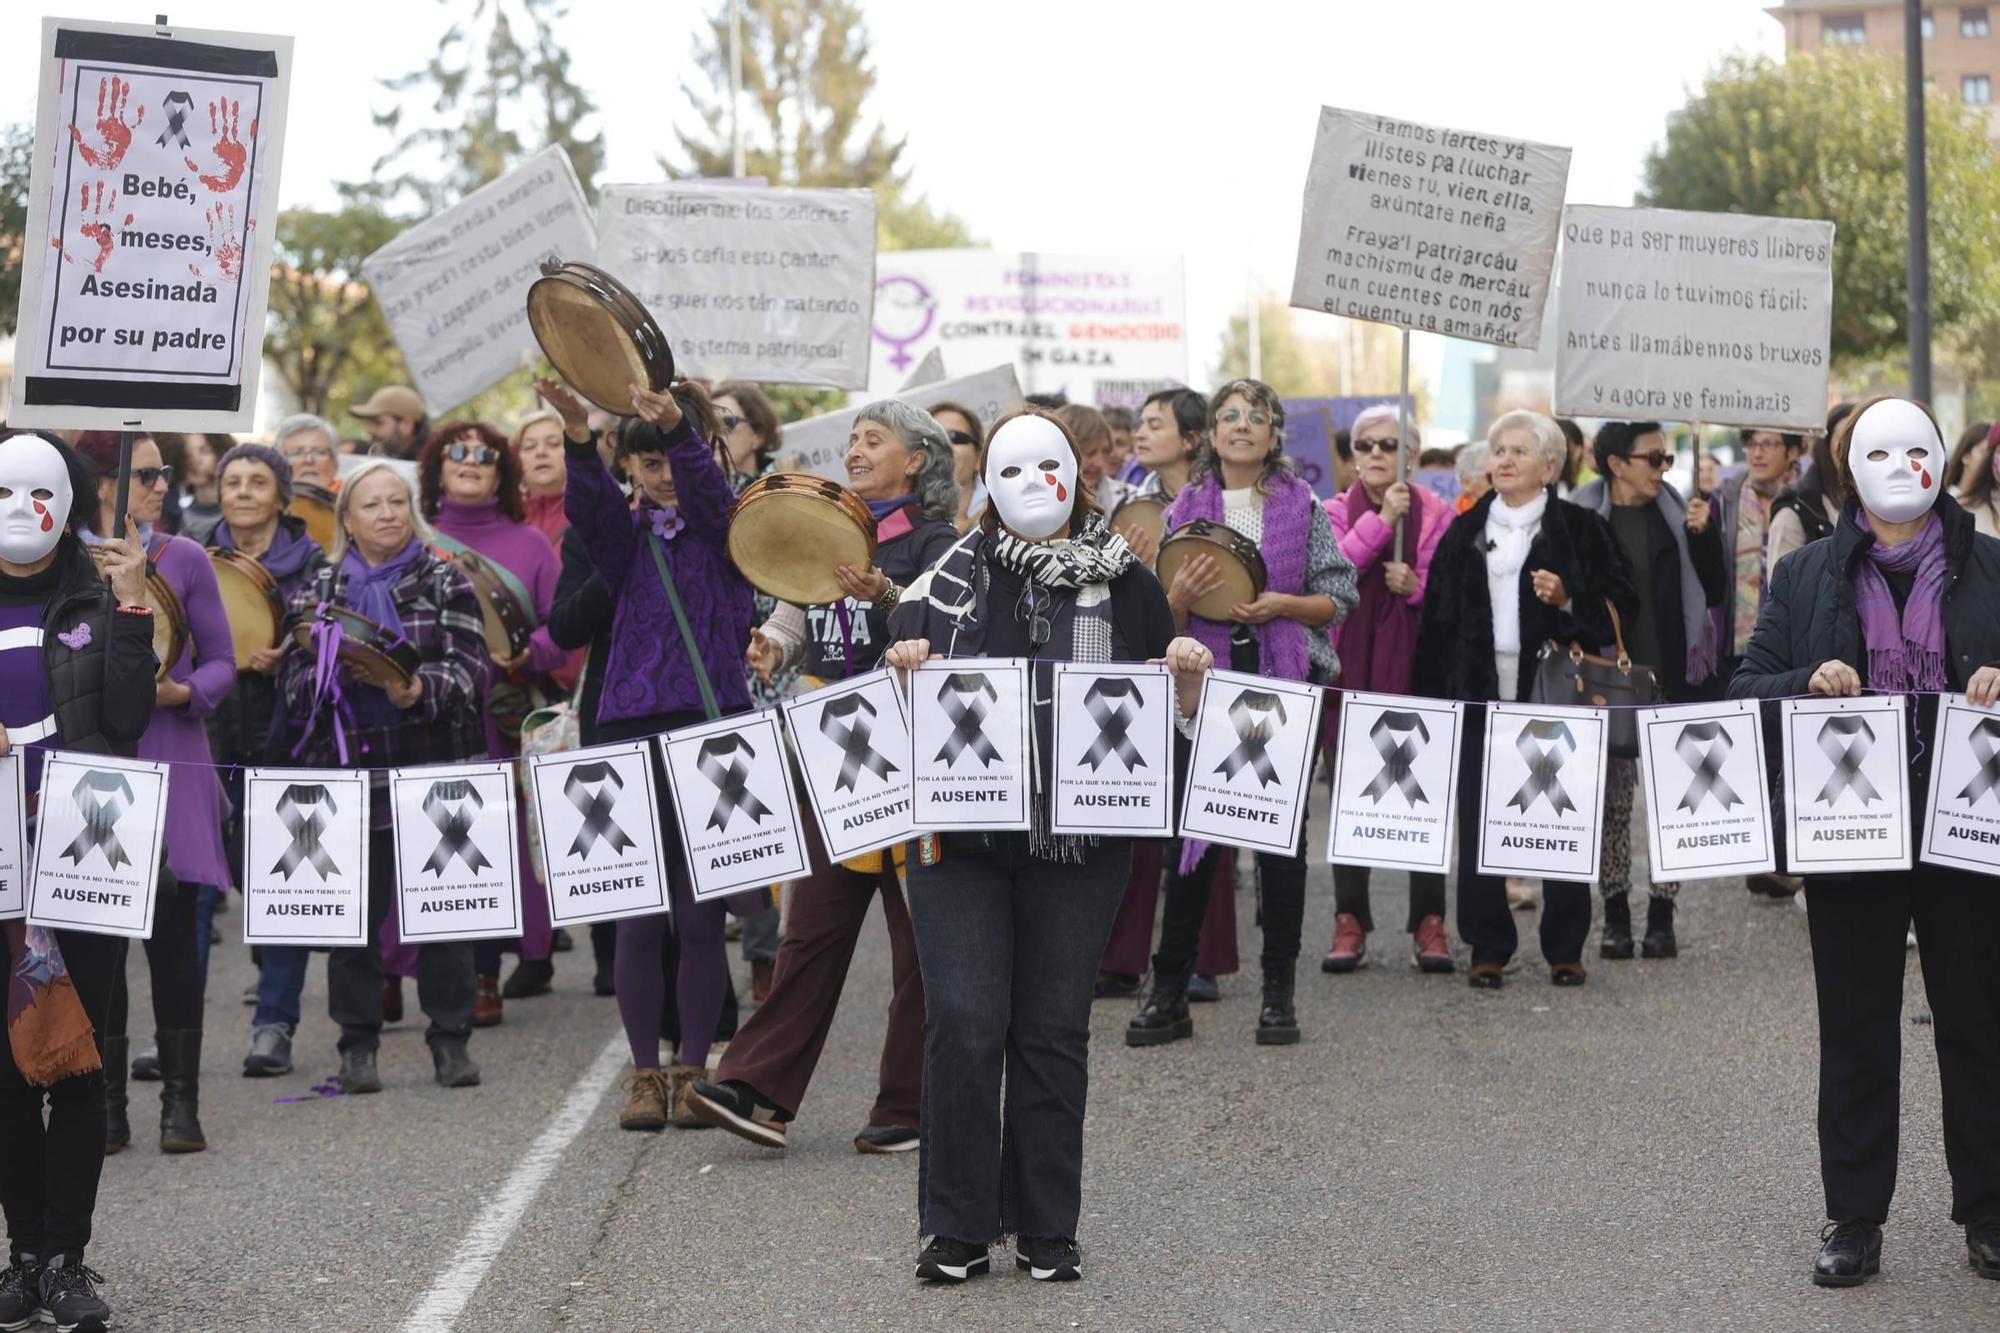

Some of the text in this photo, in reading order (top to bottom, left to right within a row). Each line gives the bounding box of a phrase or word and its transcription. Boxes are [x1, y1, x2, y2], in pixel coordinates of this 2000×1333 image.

[1441, 128, 1498, 155] fartes
[1365, 140, 1531, 186] llistes pa lluchar
[122, 173, 196, 204] Bebé,
[1349, 163, 1412, 190] vienes
[1448, 182, 1488, 203] vien
[1493, 191, 1533, 214] ella,
[746, 202, 772, 220] los
[1370, 193, 1506, 232] axúntate neña
[120, 228, 212, 256] meses,
[1566, 223, 1826, 262] Que pa ser muyeres llibres
[1416, 240, 1517, 272] patriarcáu
[1326, 248, 1530, 299] machismu de mercáu
[80, 274, 218, 303] Asesinada
[1326, 274, 1522, 322] nun cuentes con nós
[1587, 280, 1808, 311] nunca lo tuvimos fácil:
[714, 294, 744, 310] nos
[1324, 296, 1340, 312] el
[1348, 302, 1412, 326] cuentu
[60, 325, 226, 352] por su padre
[1070, 322, 1180, 340] GENOCIDIO
[681, 339, 750, 356] sistema
[756, 340, 844, 360] patriarcal
[1050, 346, 1115, 366] GAZA
[1567, 330, 1822, 366] Antes llamábennos bruxes
[1594, 384, 1790, 413] y agora ye feminazis
[931, 790, 1007, 802] AUSENTE
[1074, 795, 1150, 807] AUSENTE
[1254, 794, 1273, 803] TIENE
[1204, 802, 1279, 825] AUSENTE
[1352, 826, 1429, 843] AUSENTE
[1501, 836, 1578, 852] AUSENTE
[1677, 832, 1751, 849] AUSENTE
[1812, 828, 1888, 841] AUSENTE
[711, 842, 784, 870] AUSENTE
[51, 888, 131, 906] AUSENTE
[569, 876, 645, 897] AUSENTE
[266, 904, 345, 916] AUSENTE
[420, 897, 498, 913] AUSENTE
